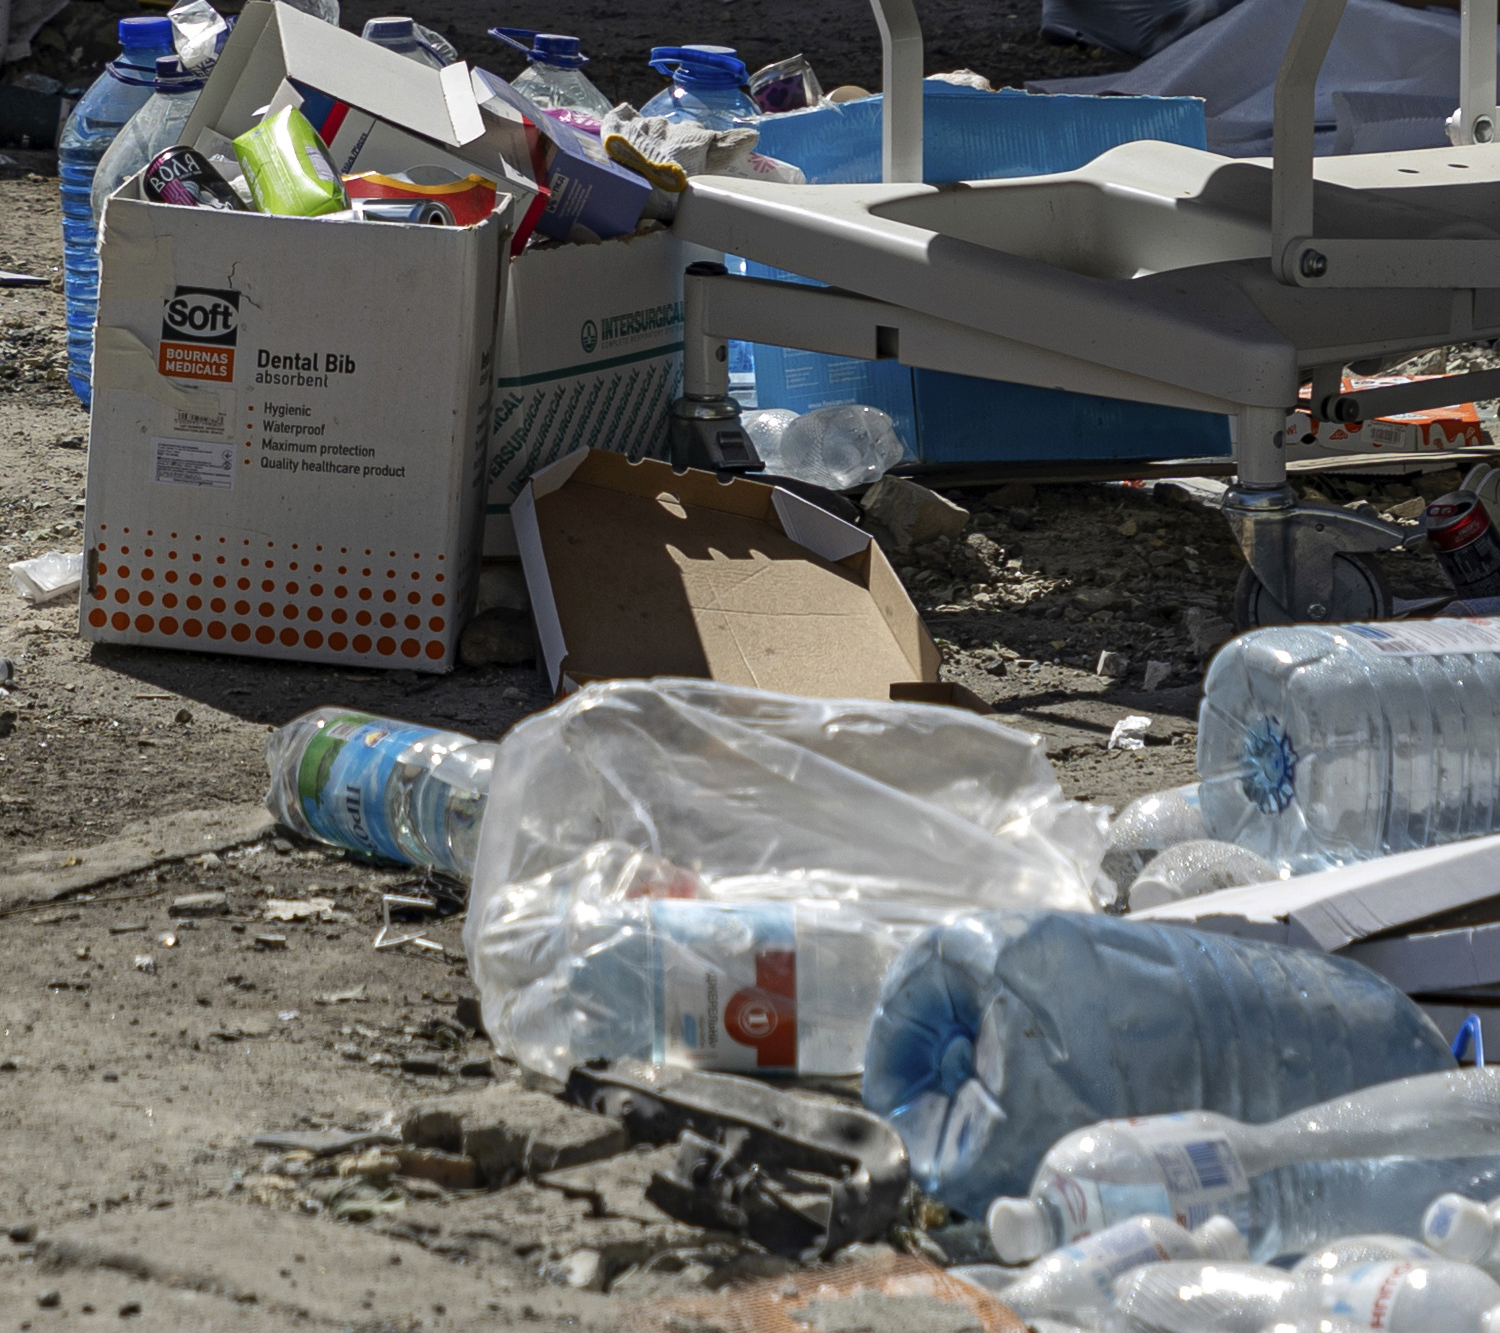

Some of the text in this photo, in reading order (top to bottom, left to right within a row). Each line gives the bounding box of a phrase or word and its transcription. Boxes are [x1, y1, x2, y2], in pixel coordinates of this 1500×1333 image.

[149, 152, 200, 193] ВОЛЯ
[166, 298, 234, 332] Soft
[165, 347, 229, 366] BOURNAS
[257, 348, 356, 375] Dental Bib
[165, 361, 228, 379] MEDICALS
[254, 370, 329, 389] absorbent
[263, 402, 312, 419] Hygienic
[262, 419, 326, 437] Waterproof
[261, 438, 376, 459] Maximum protection
[260, 455, 407, 481] Quality healthcare product
